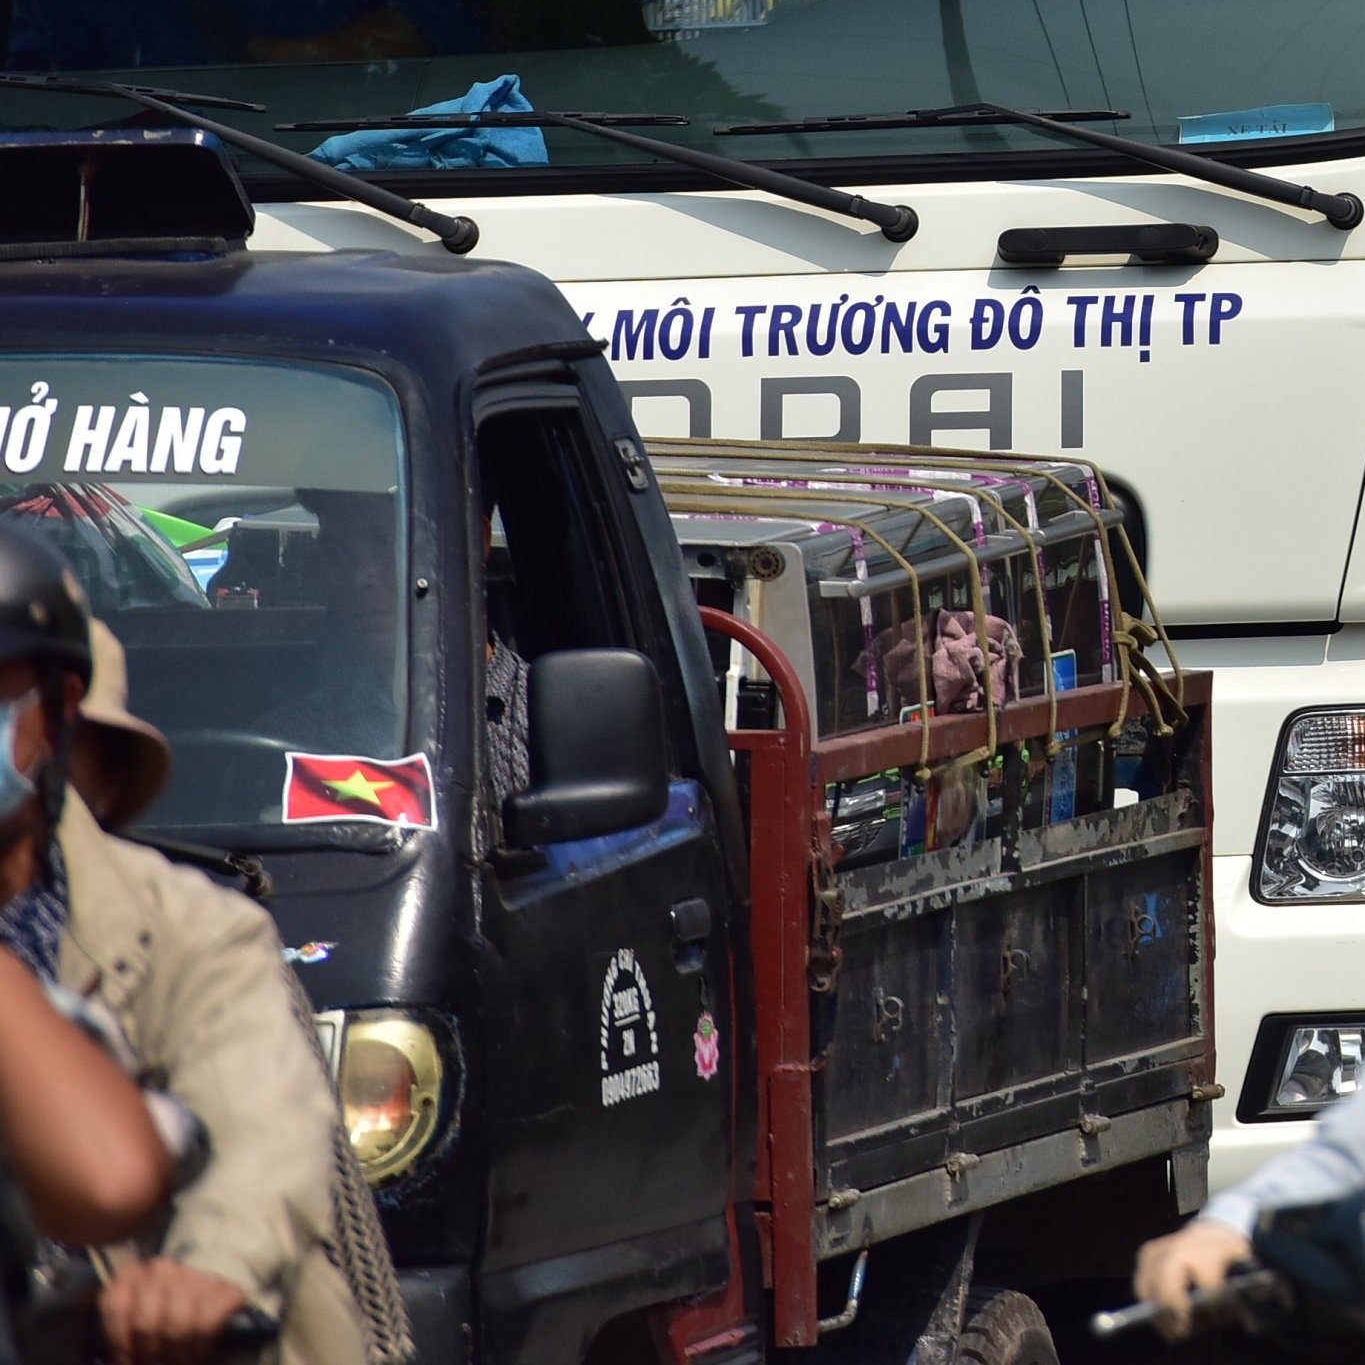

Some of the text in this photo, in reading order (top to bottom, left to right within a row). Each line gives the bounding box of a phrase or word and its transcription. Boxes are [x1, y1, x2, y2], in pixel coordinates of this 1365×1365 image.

[611, 285, 1243, 363] MÔI TRƯƠNG ĐÔ THỊ TP
[63, 391, 247, 475] HÀNG
